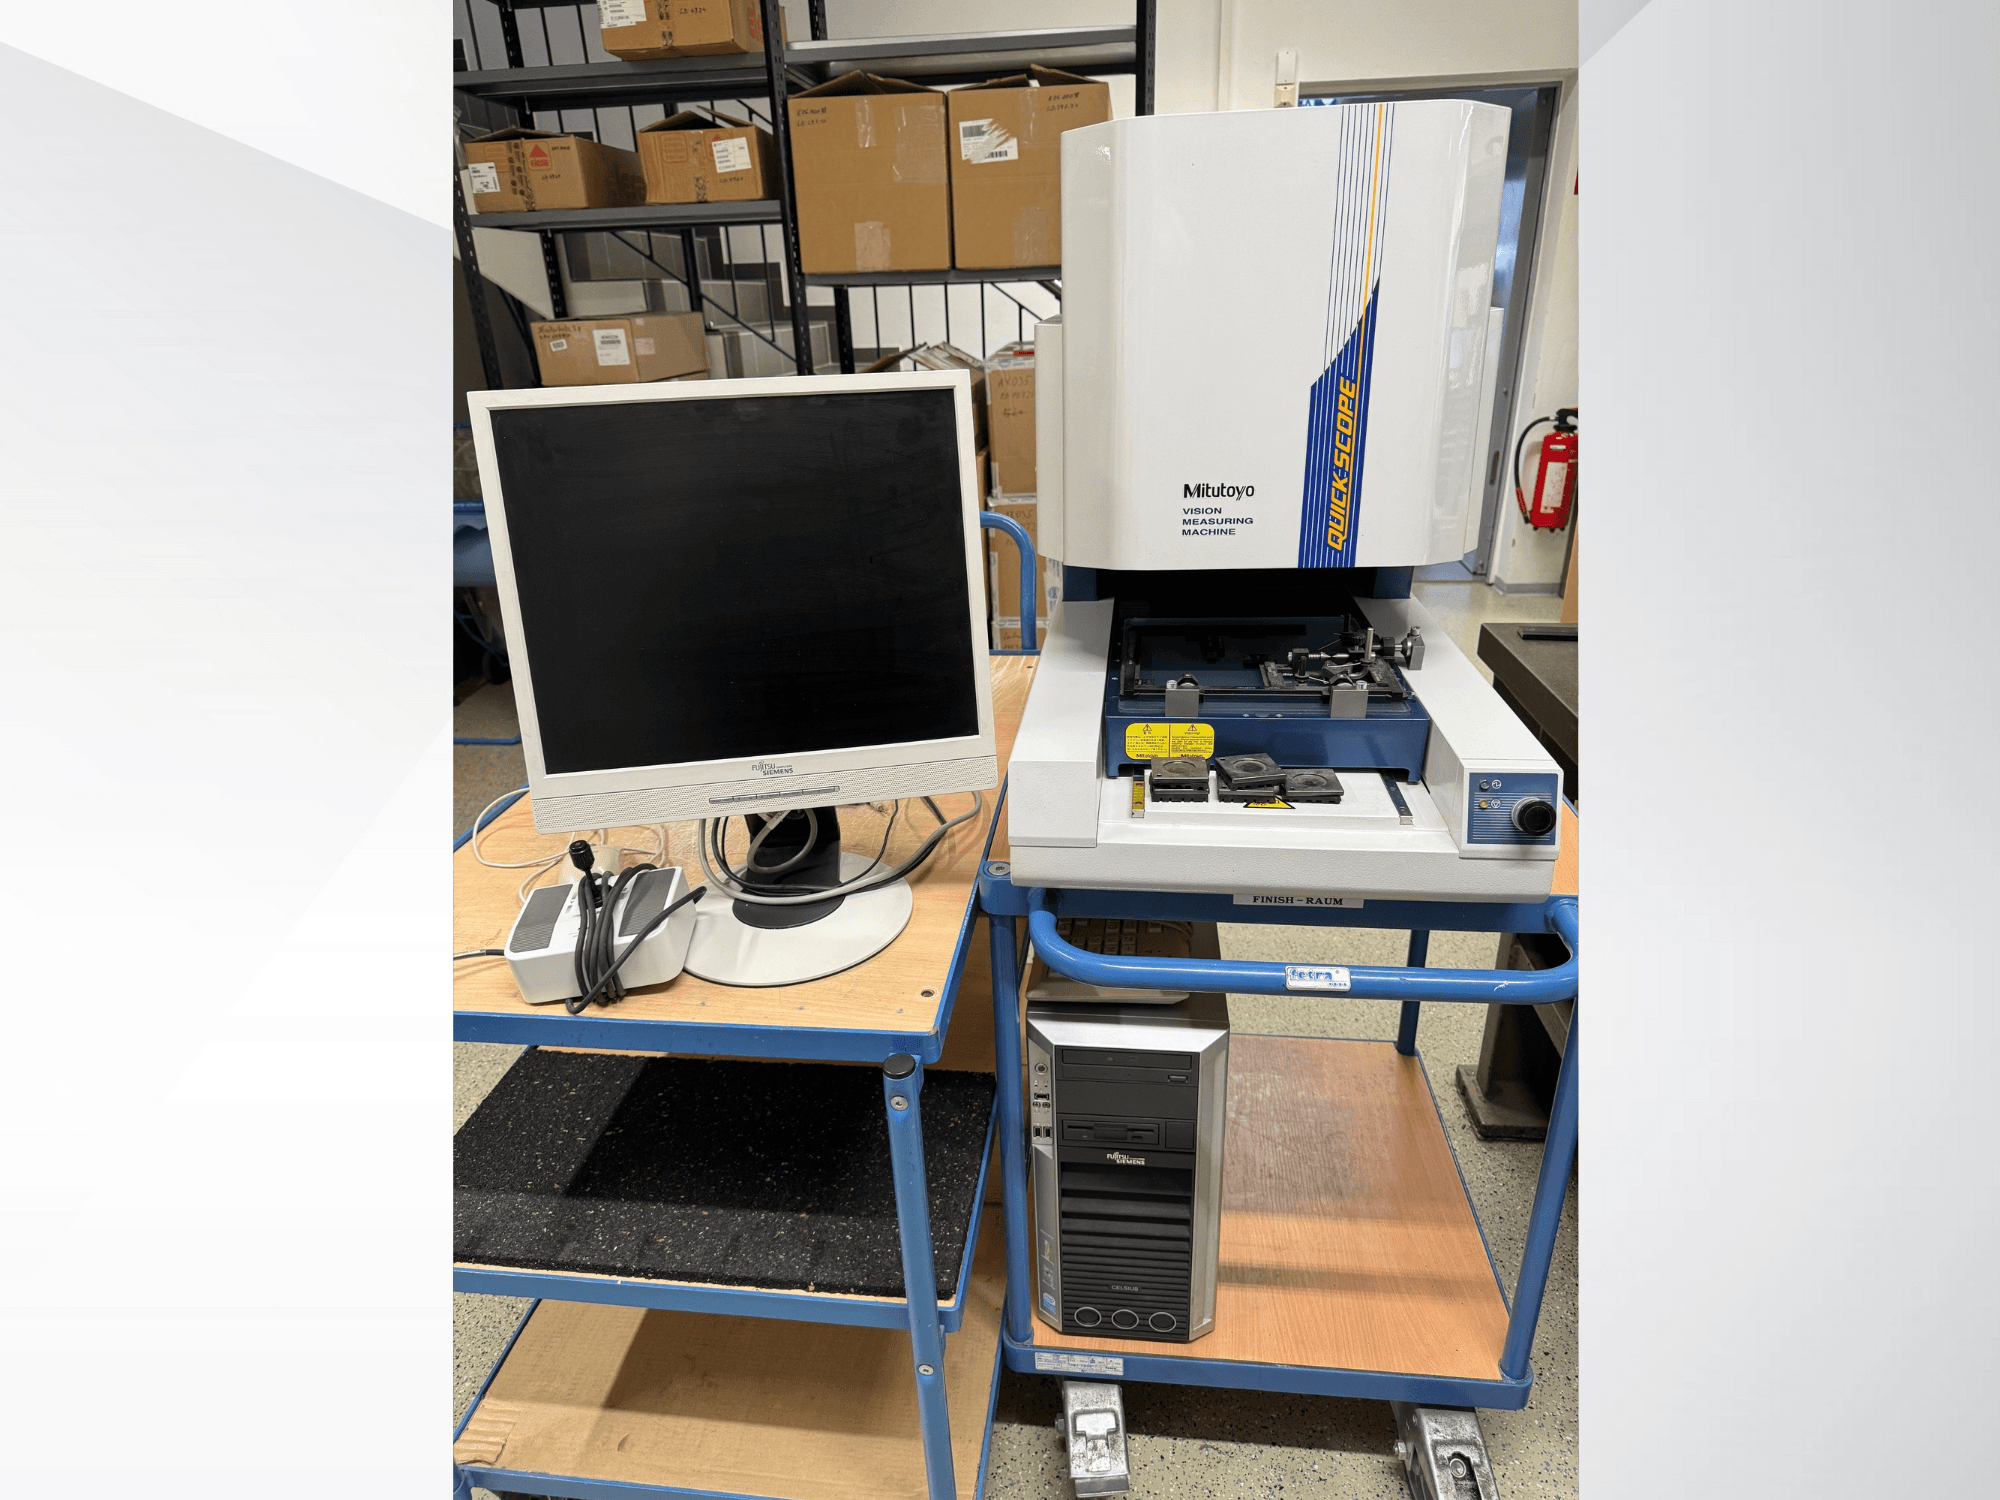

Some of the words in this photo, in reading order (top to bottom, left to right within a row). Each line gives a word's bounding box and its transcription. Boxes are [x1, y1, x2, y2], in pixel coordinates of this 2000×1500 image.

[1333, 376, 1356, 472] SCOPE
[1183, 483, 1255, 501] Mitutoyo
[1327, 471, 1349, 551] QUICK
[1182, 517, 1254, 526] MEASURING
[1182, 528, 1236, 536] MACHINE
[752, 761, 776, 772] FUJITSU
[762, 768, 794, 776] SIEMENS
[1252, 896, 1294, 904] FINISH
[1306, 897, 1343, 905] RAUM
[1290, 968, 1332, 981] fetra
[1106, 1151, 1129, 1160] FUJITSU
[1111, 1284, 1139, 1292] CELSIUS
